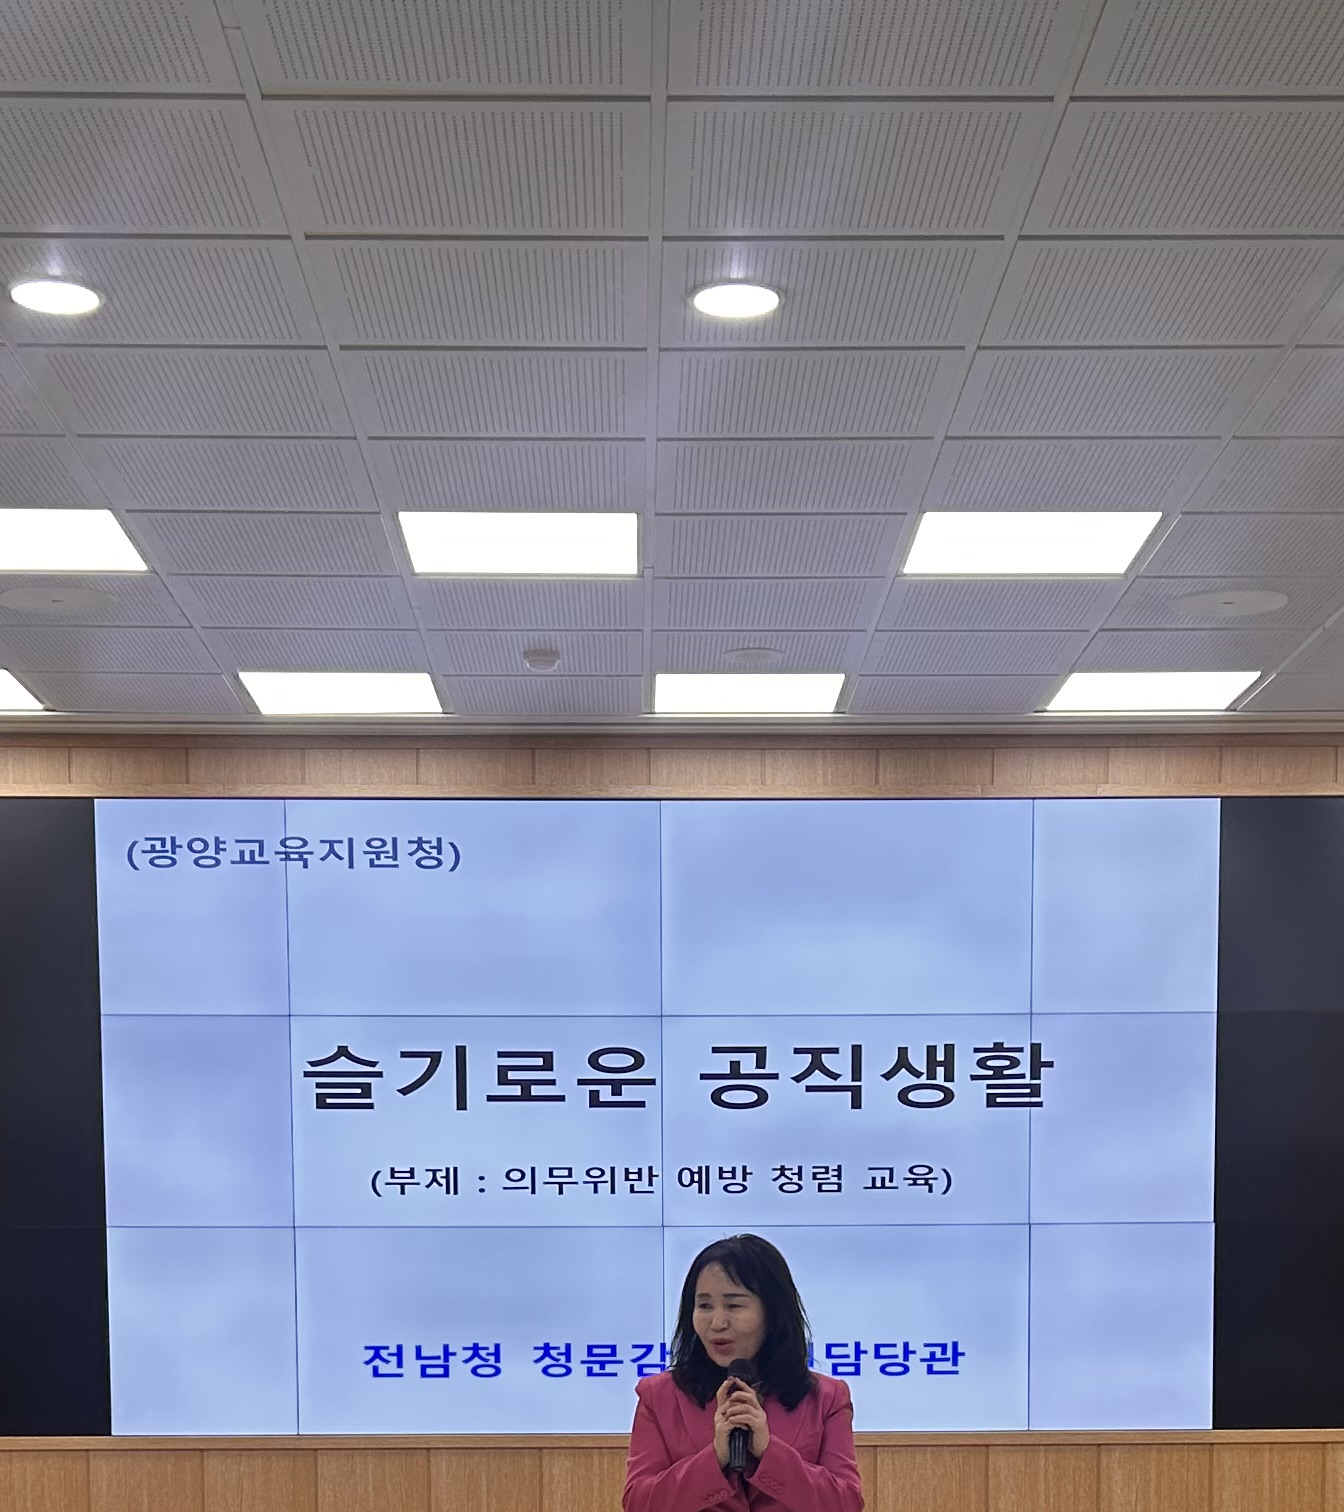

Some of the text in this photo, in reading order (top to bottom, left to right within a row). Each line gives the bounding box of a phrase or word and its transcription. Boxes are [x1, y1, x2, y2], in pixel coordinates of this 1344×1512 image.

[126, 835, 461, 872] (광양교육지원청)
[302, 1042, 1055, 1110] 슬기로운 공직생활
[371, 1165, 459, 1197] (부제
[502, 1164, 660, 1195] 의무위반
[677, 1164, 754, 1194] 예방
[771, 1163, 843, 1194] 청렴
[862, 1164, 952, 1195] 교육)
[362, 1342, 502, 1378] 전남청
